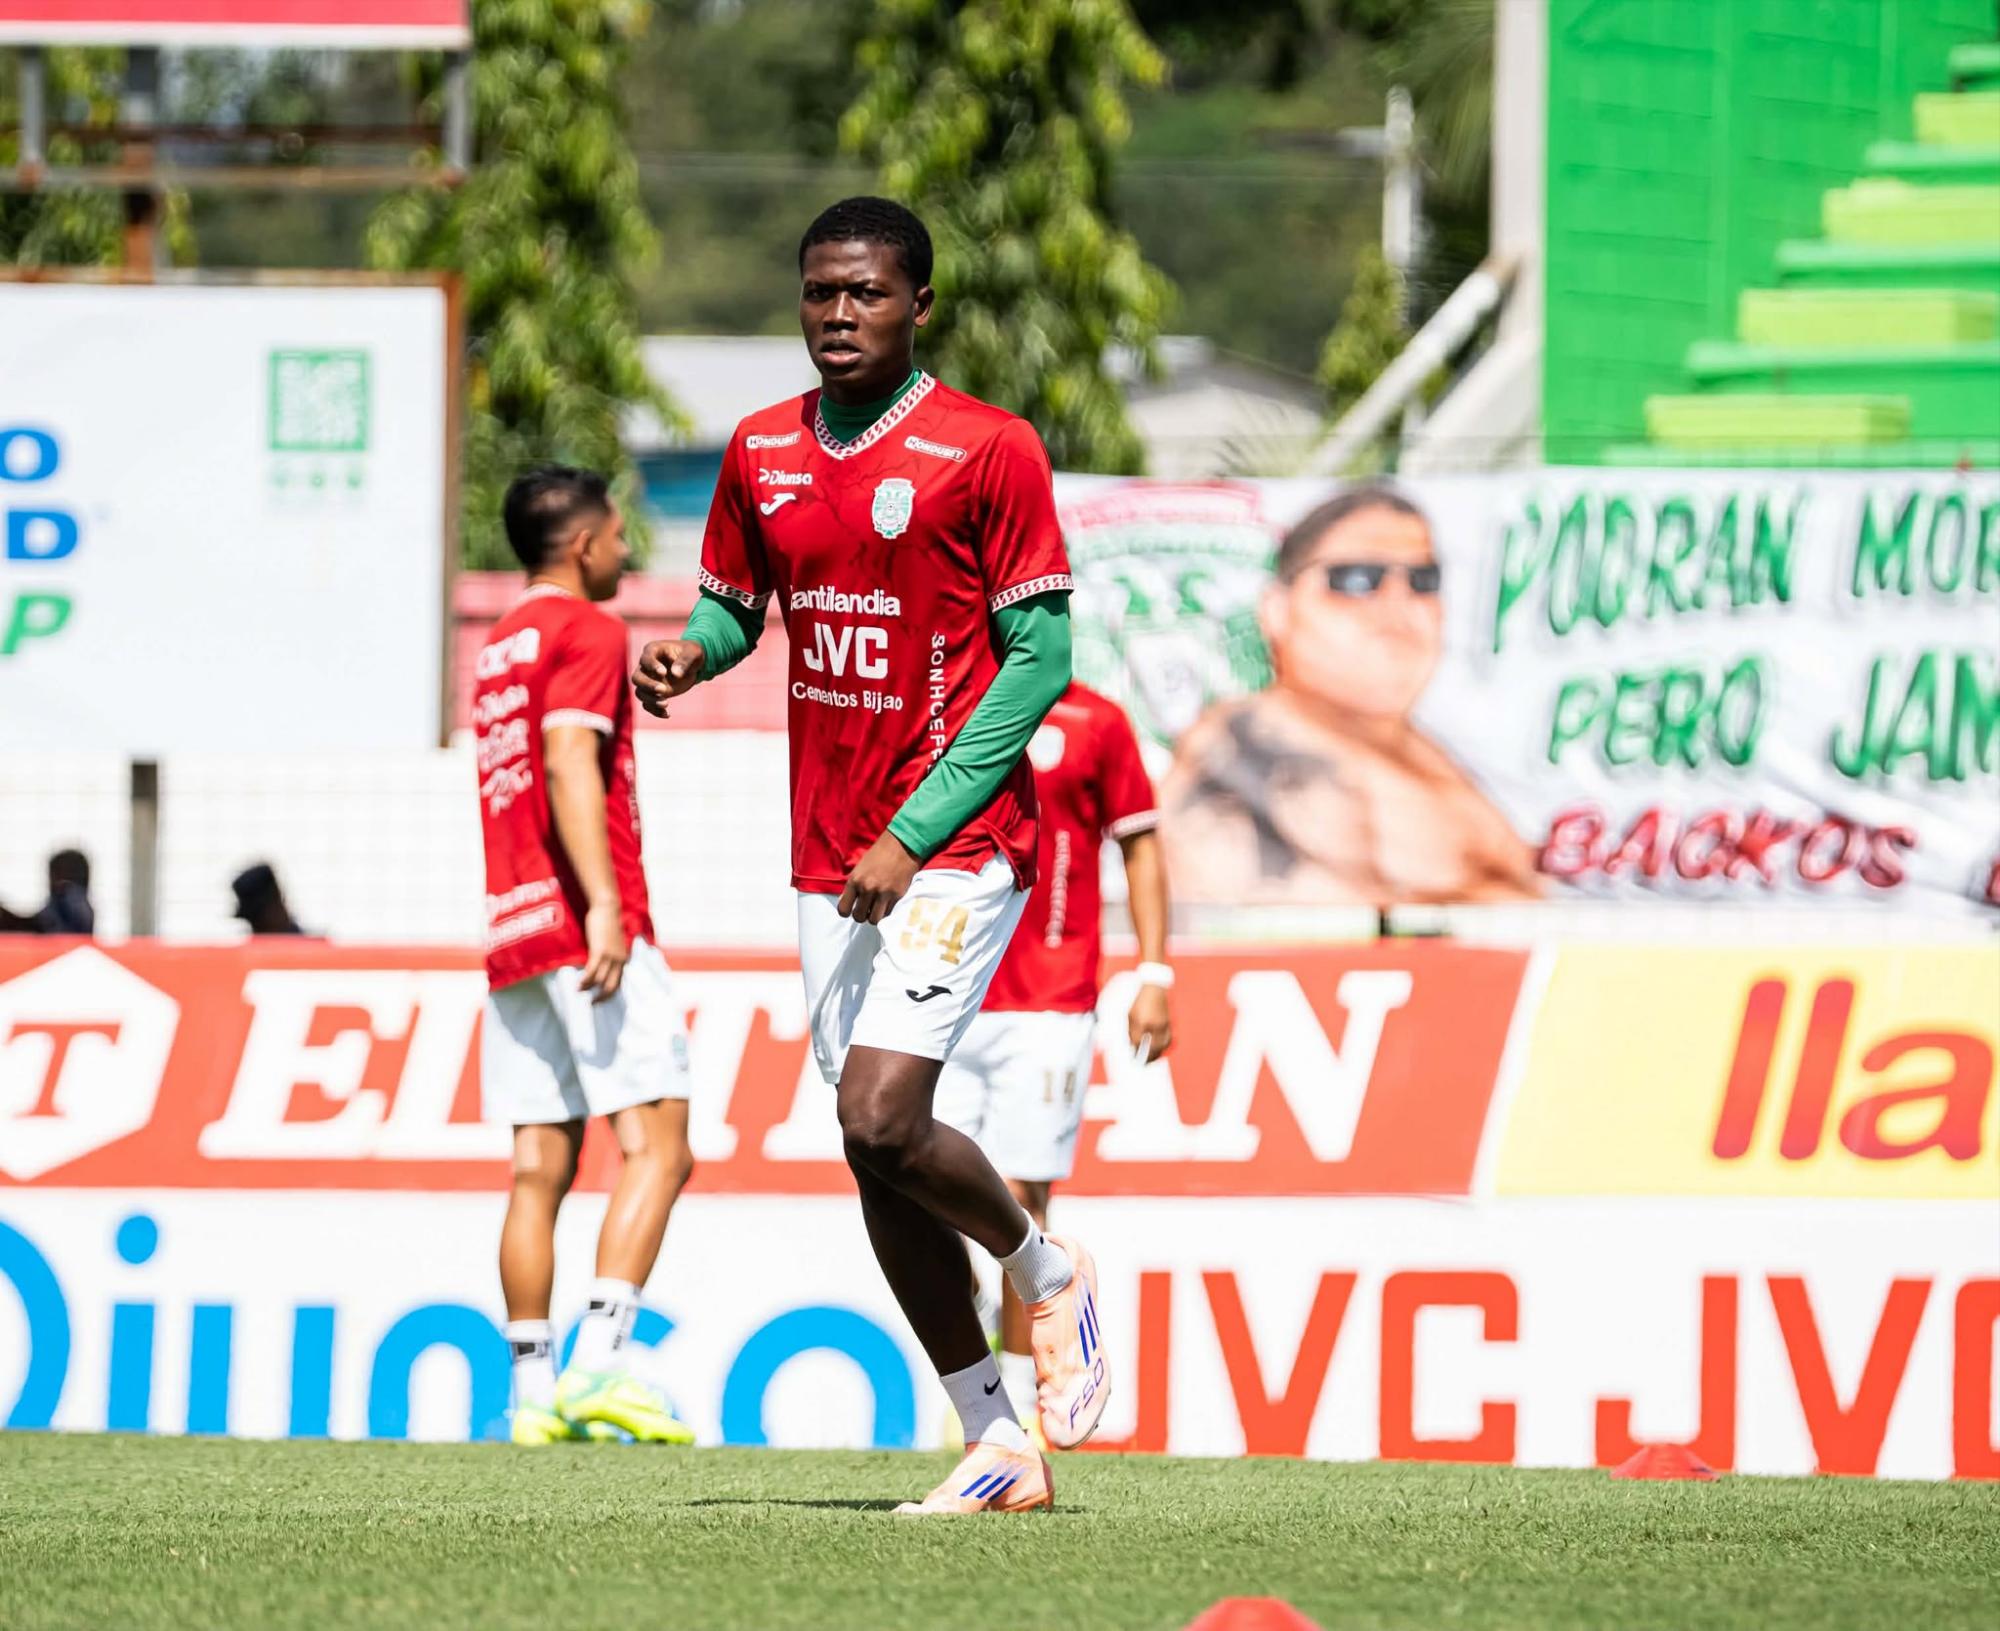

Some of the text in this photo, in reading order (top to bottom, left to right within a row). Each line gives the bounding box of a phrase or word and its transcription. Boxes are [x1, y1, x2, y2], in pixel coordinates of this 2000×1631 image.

[803, 622, 888, 679] JVC
[792, 681, 904, 714] Cementos Bijao
[1548, 658, 1762, 769] PERO
[900, 897, 970, 966] 54
[1034, 1270, 1519, 1464] JVC
